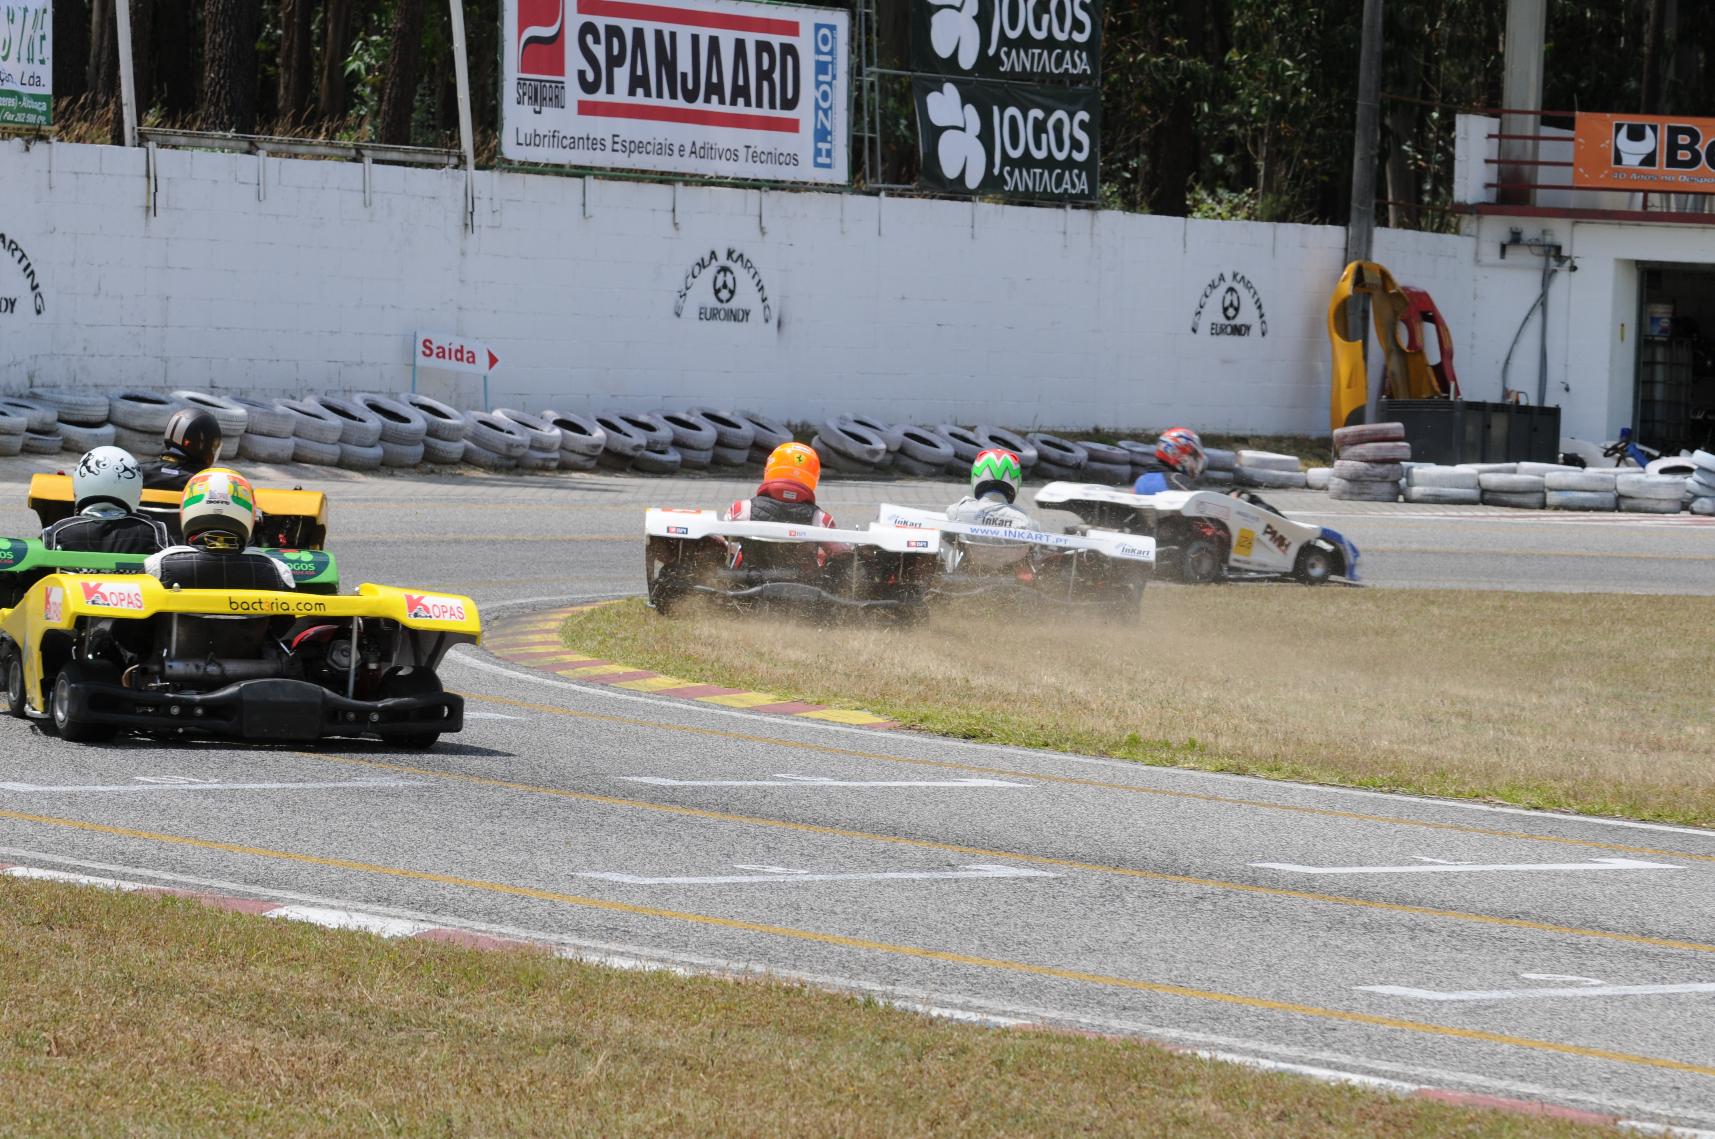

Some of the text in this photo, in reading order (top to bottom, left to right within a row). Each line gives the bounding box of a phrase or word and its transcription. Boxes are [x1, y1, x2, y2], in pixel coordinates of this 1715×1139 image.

[987, 0, 1092, 57] JOGOS
[20, 71, 46, 87] Lda.
[577, 21, 800, 111] SPANJAARD
[516, 80, 565, 114] SPANJAARD
[515, 127, 799, 166] Lubrificantes Especiais e Aditivos Técnicos
[992, 105, 1090, 176] JOGOS
[675, 247, 772, 324] ESCOLA KARTING
[699, 306, 751, 322] EUROINDY
[421, 338, 476, 364] Saída
[81, 582, 143, 609] KOPAS
[405, 594, 465, 620] KOPAS
